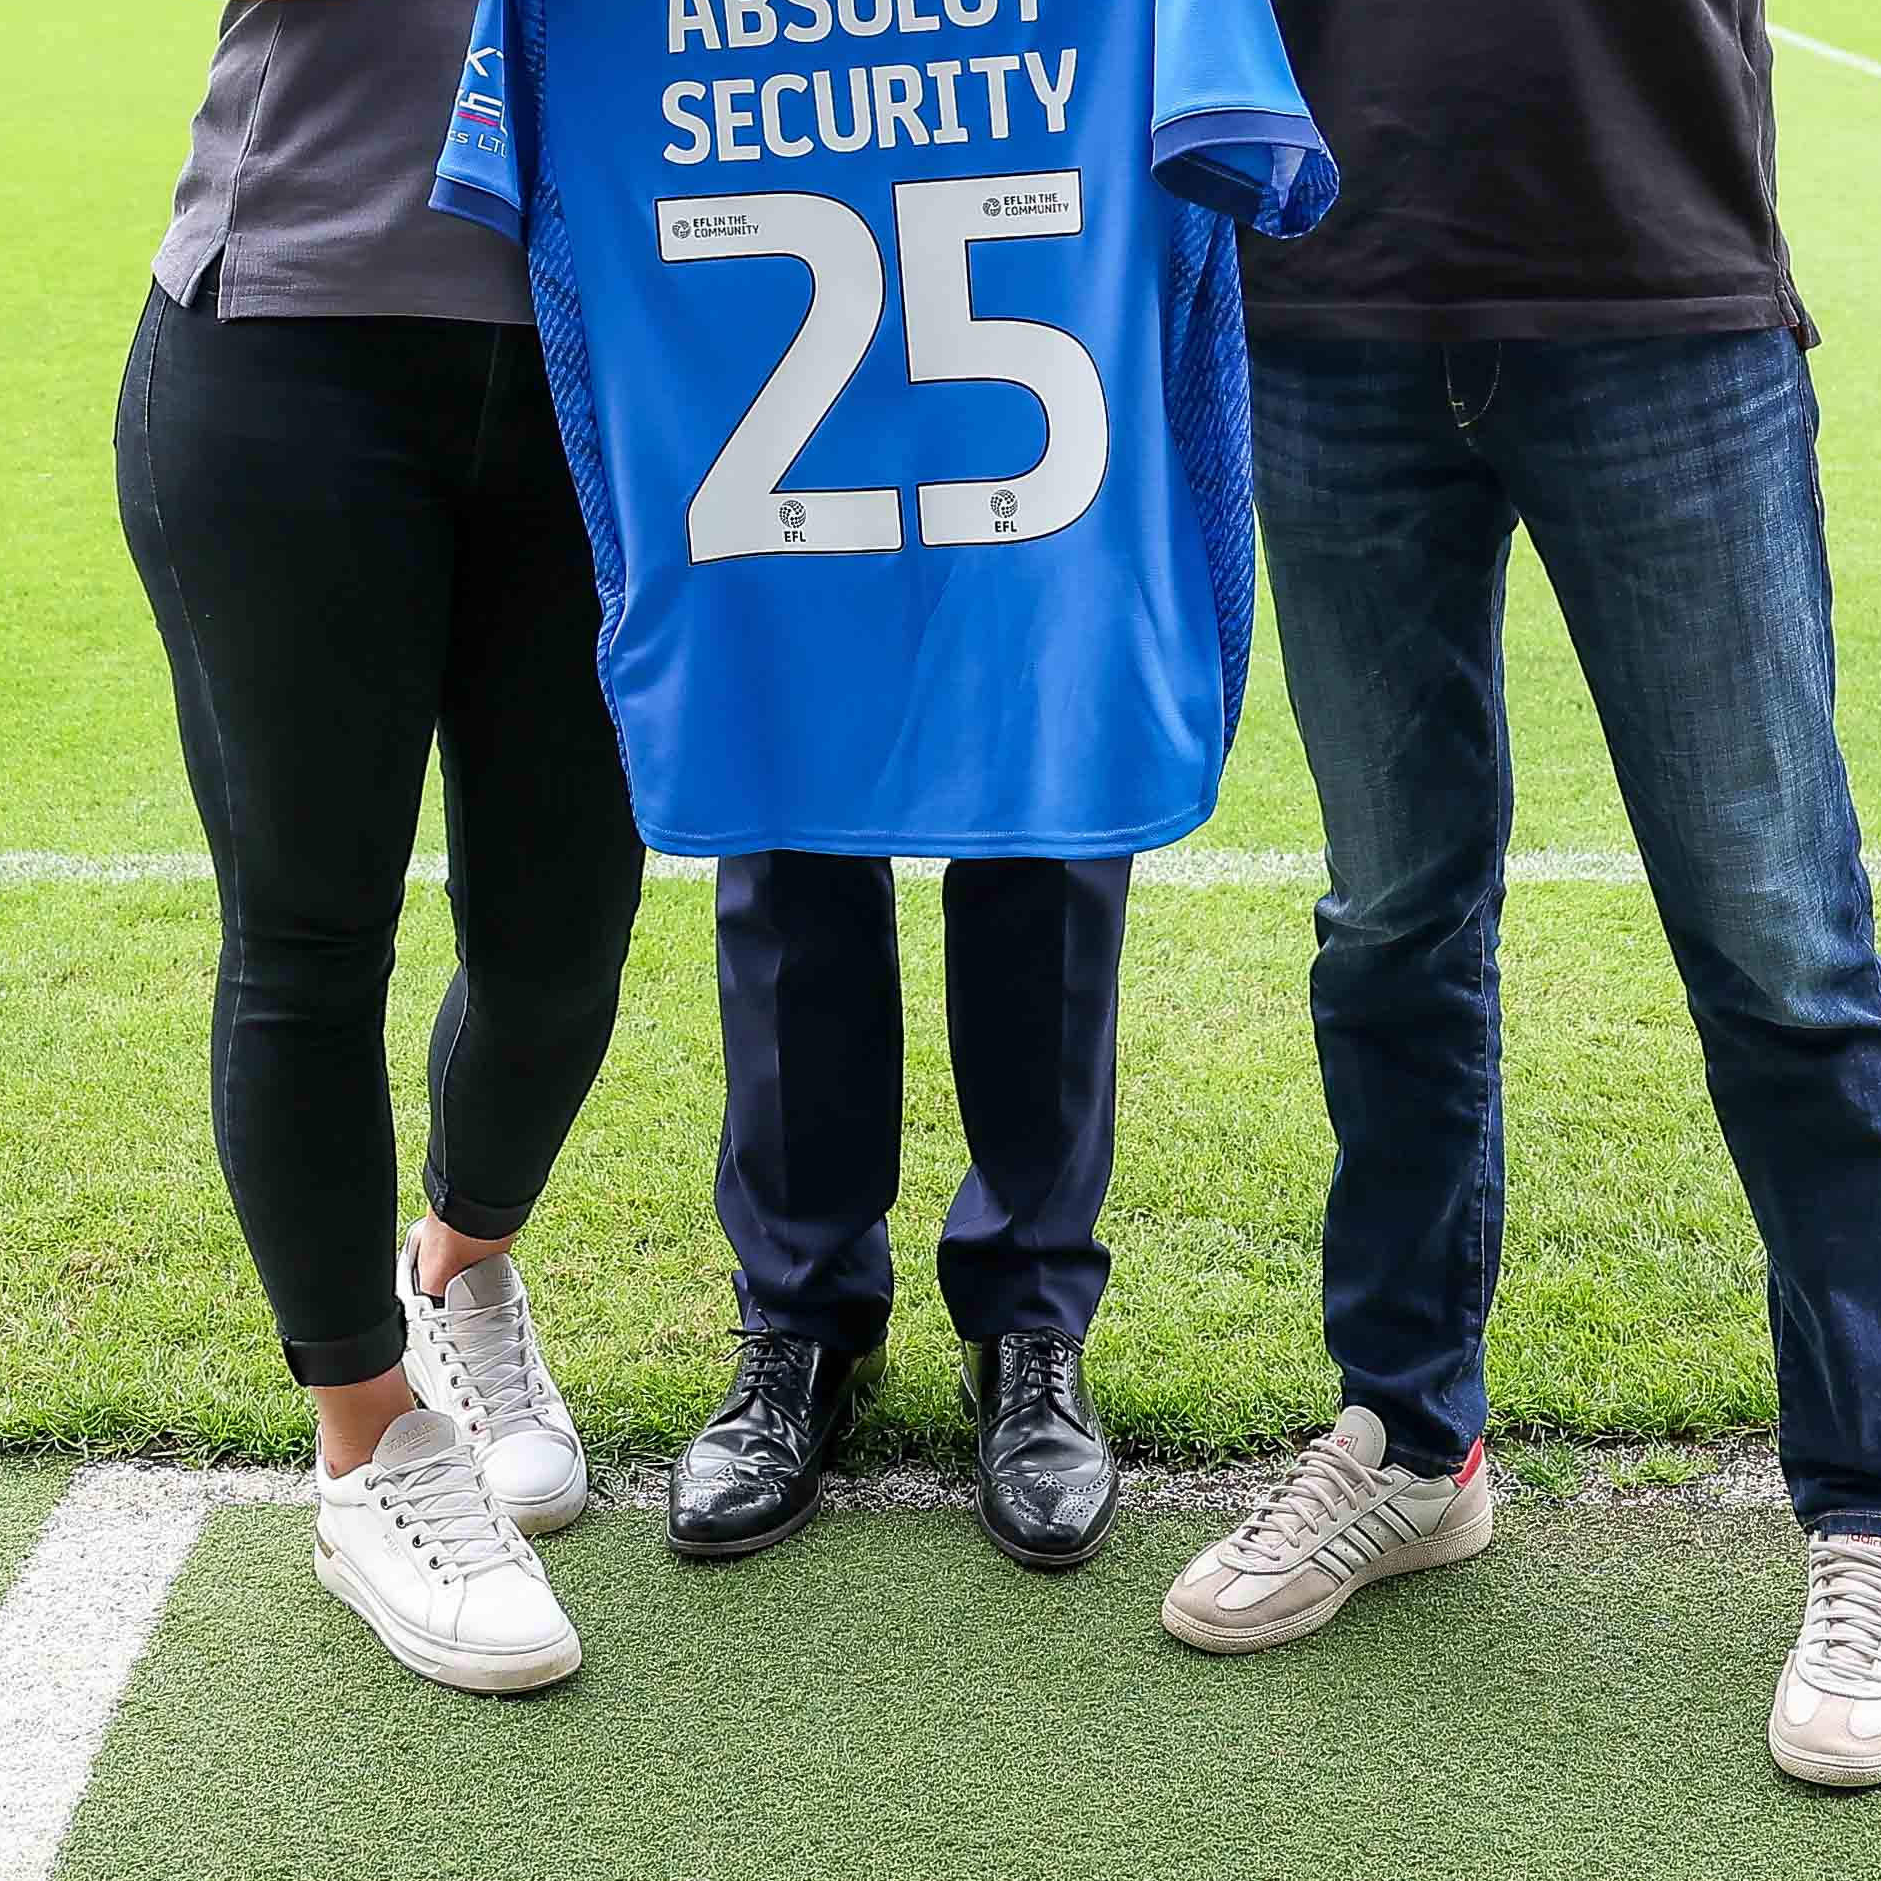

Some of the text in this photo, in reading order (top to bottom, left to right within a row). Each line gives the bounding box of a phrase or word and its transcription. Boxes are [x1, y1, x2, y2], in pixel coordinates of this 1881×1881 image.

[662, 48, 1078, 165] SECURITY
[1004, 193, 1058, 206] EFL IN THE
[1004, 203, 1069, 217] COMMUNITY
[693, 214, 748, 228] EFL IN THE
[694, 225, 759, 239] COMMUNITY
[655, 168, 1110, 565] 25
[994, 520, 1018, 533] EFL
[784, 530, 806, 543] EFL
